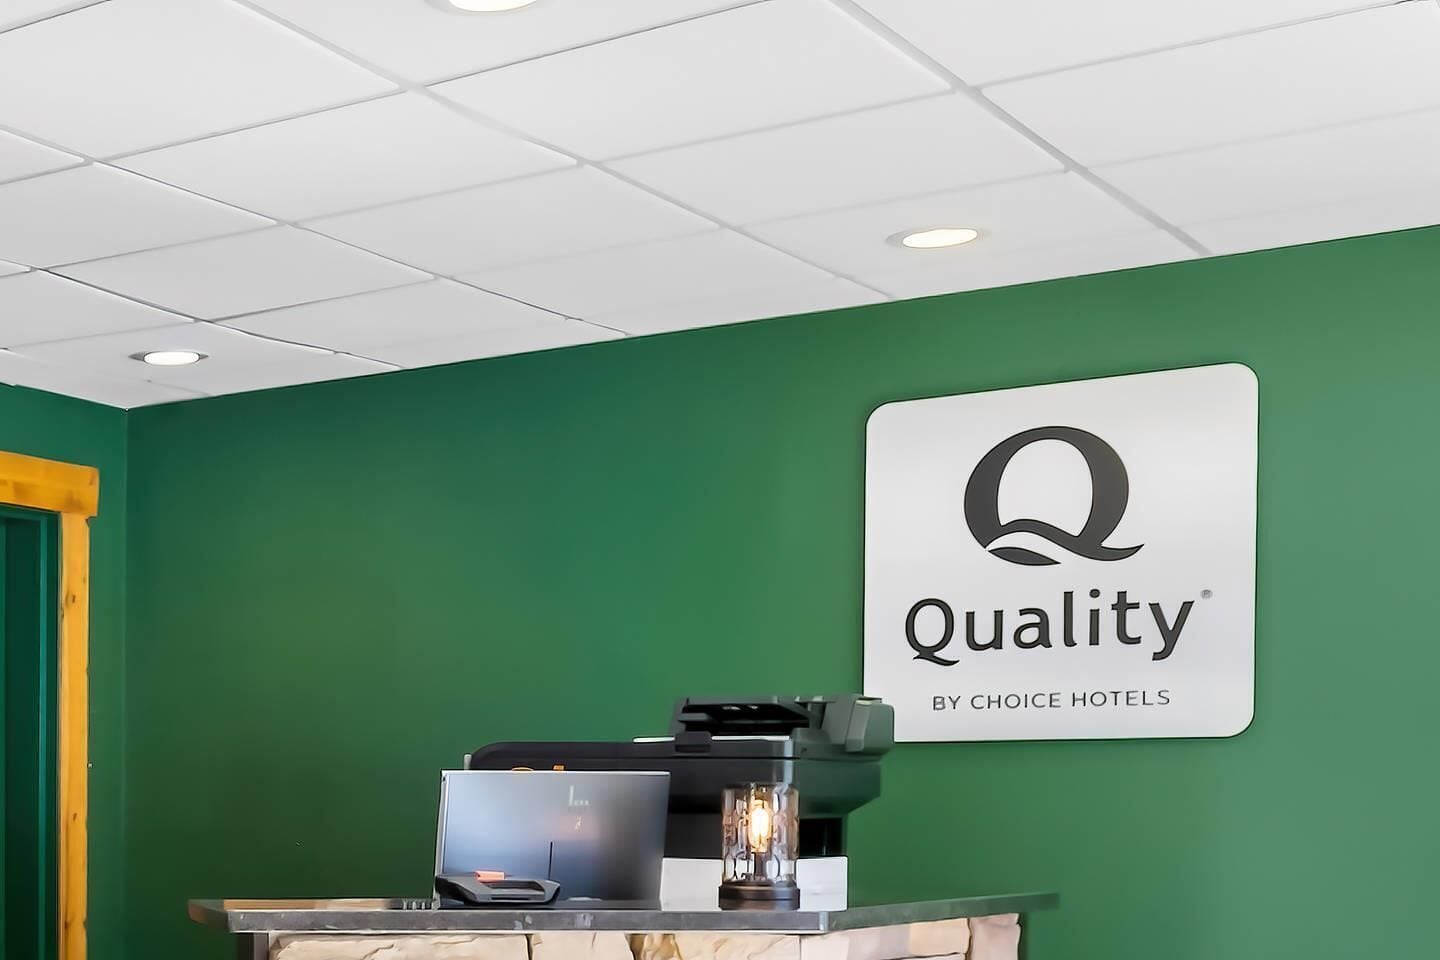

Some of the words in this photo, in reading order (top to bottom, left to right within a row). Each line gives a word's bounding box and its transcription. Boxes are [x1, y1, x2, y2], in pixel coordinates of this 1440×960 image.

[964, 426, 1144, 566] Q
[905, 588, 1195, 666] Quality
[932, 695, 961, 711] BY
[970, 693, 1062, 711] CHOICE
[1071, 690, 1172, 707] HOTELS
